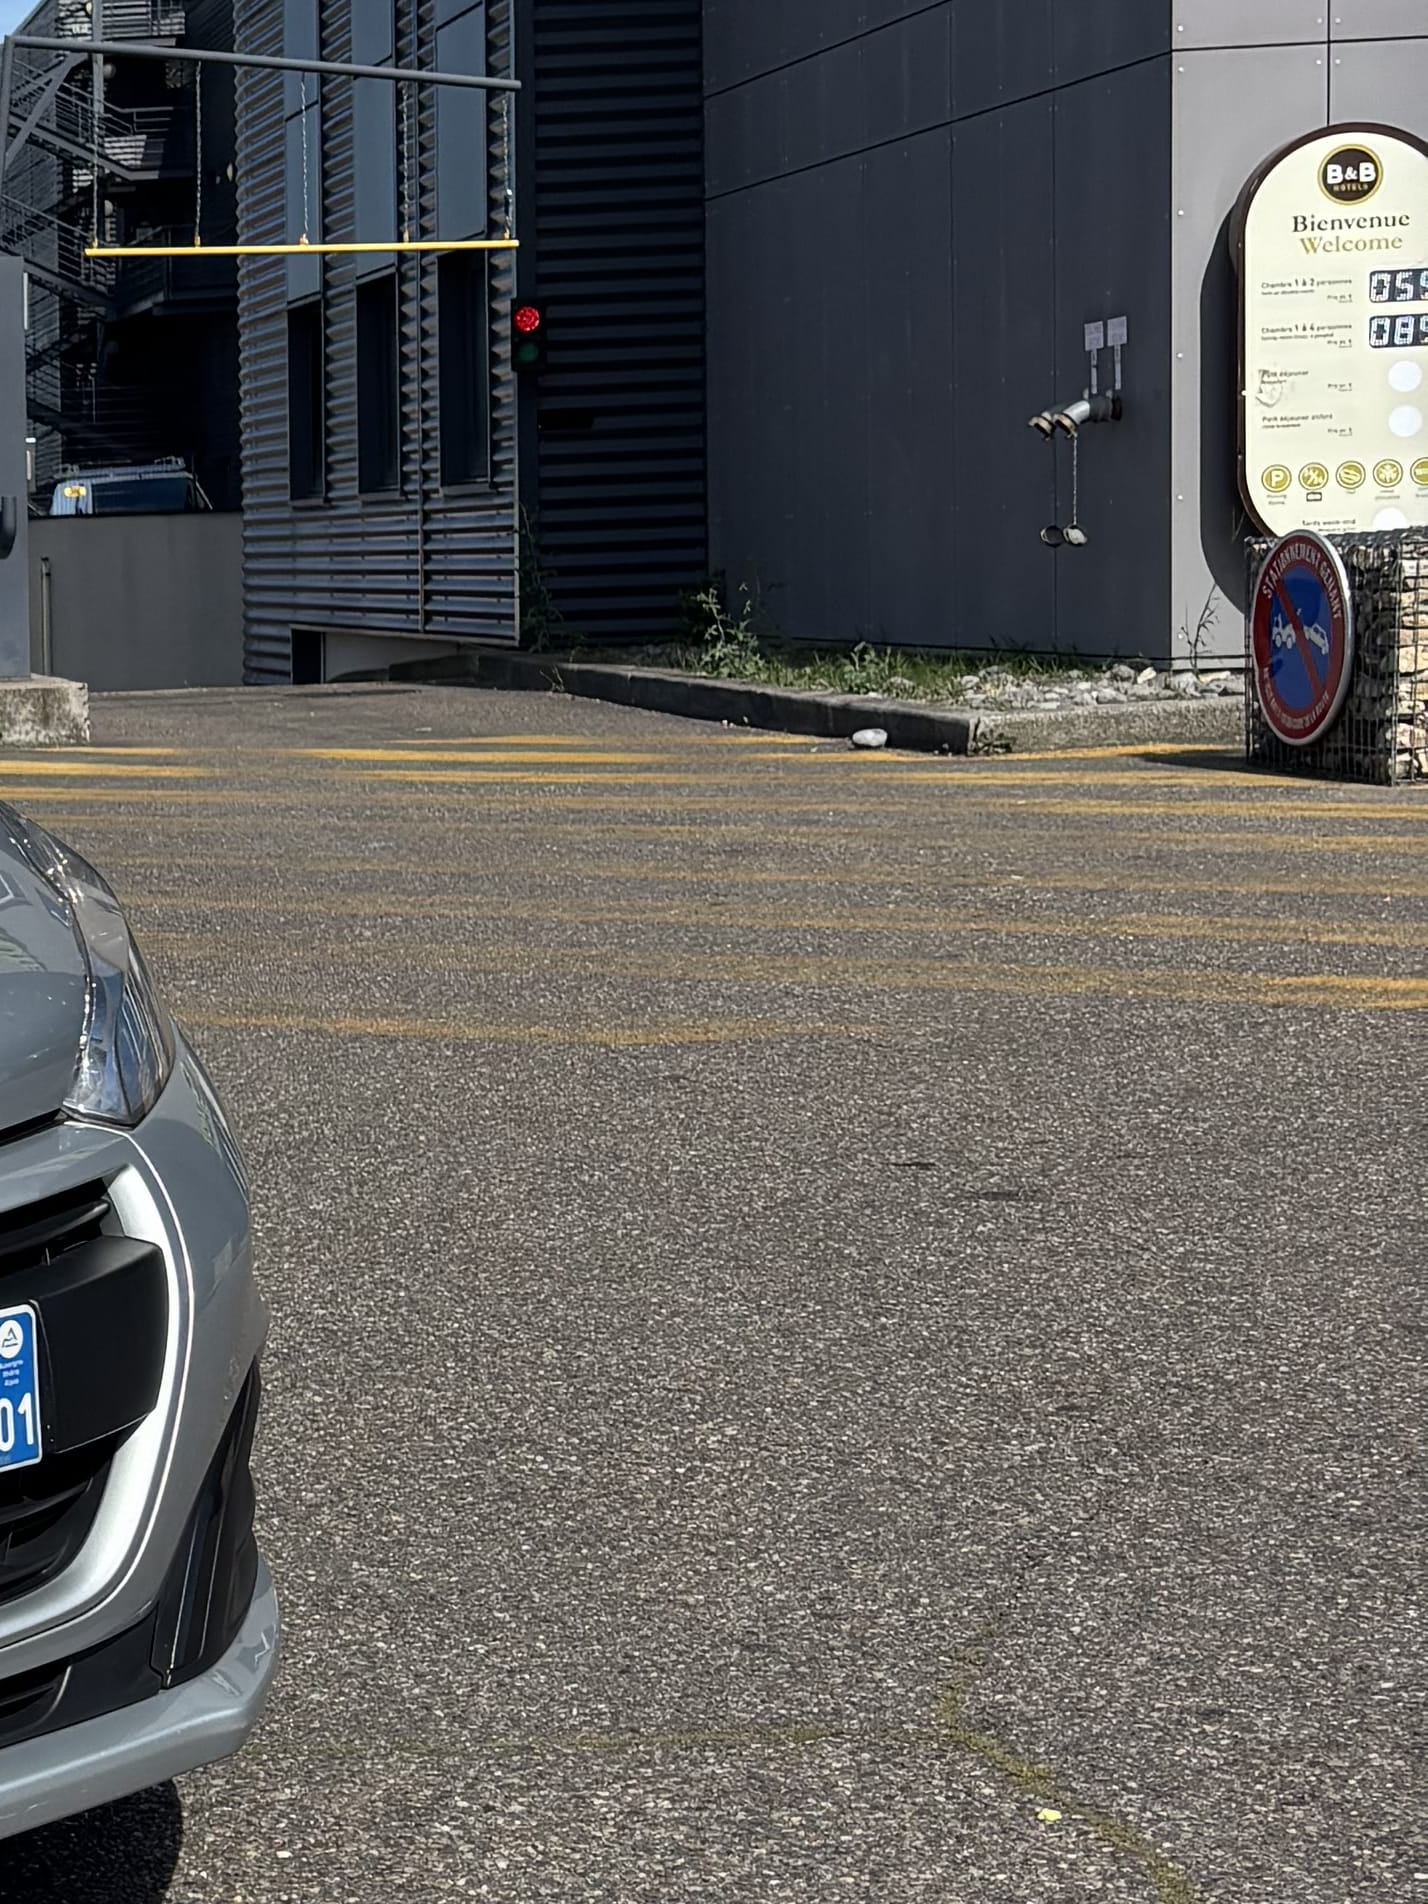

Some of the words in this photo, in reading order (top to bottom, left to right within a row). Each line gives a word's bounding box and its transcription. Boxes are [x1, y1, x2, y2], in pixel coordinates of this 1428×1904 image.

[1326, 162, 1376, 184] B&B
[1332, 183, 1369, 192] HOTELS
[1292, 214, 1410, 233] Bienvenue
[1300, 236, 1403, 255] Welcome
